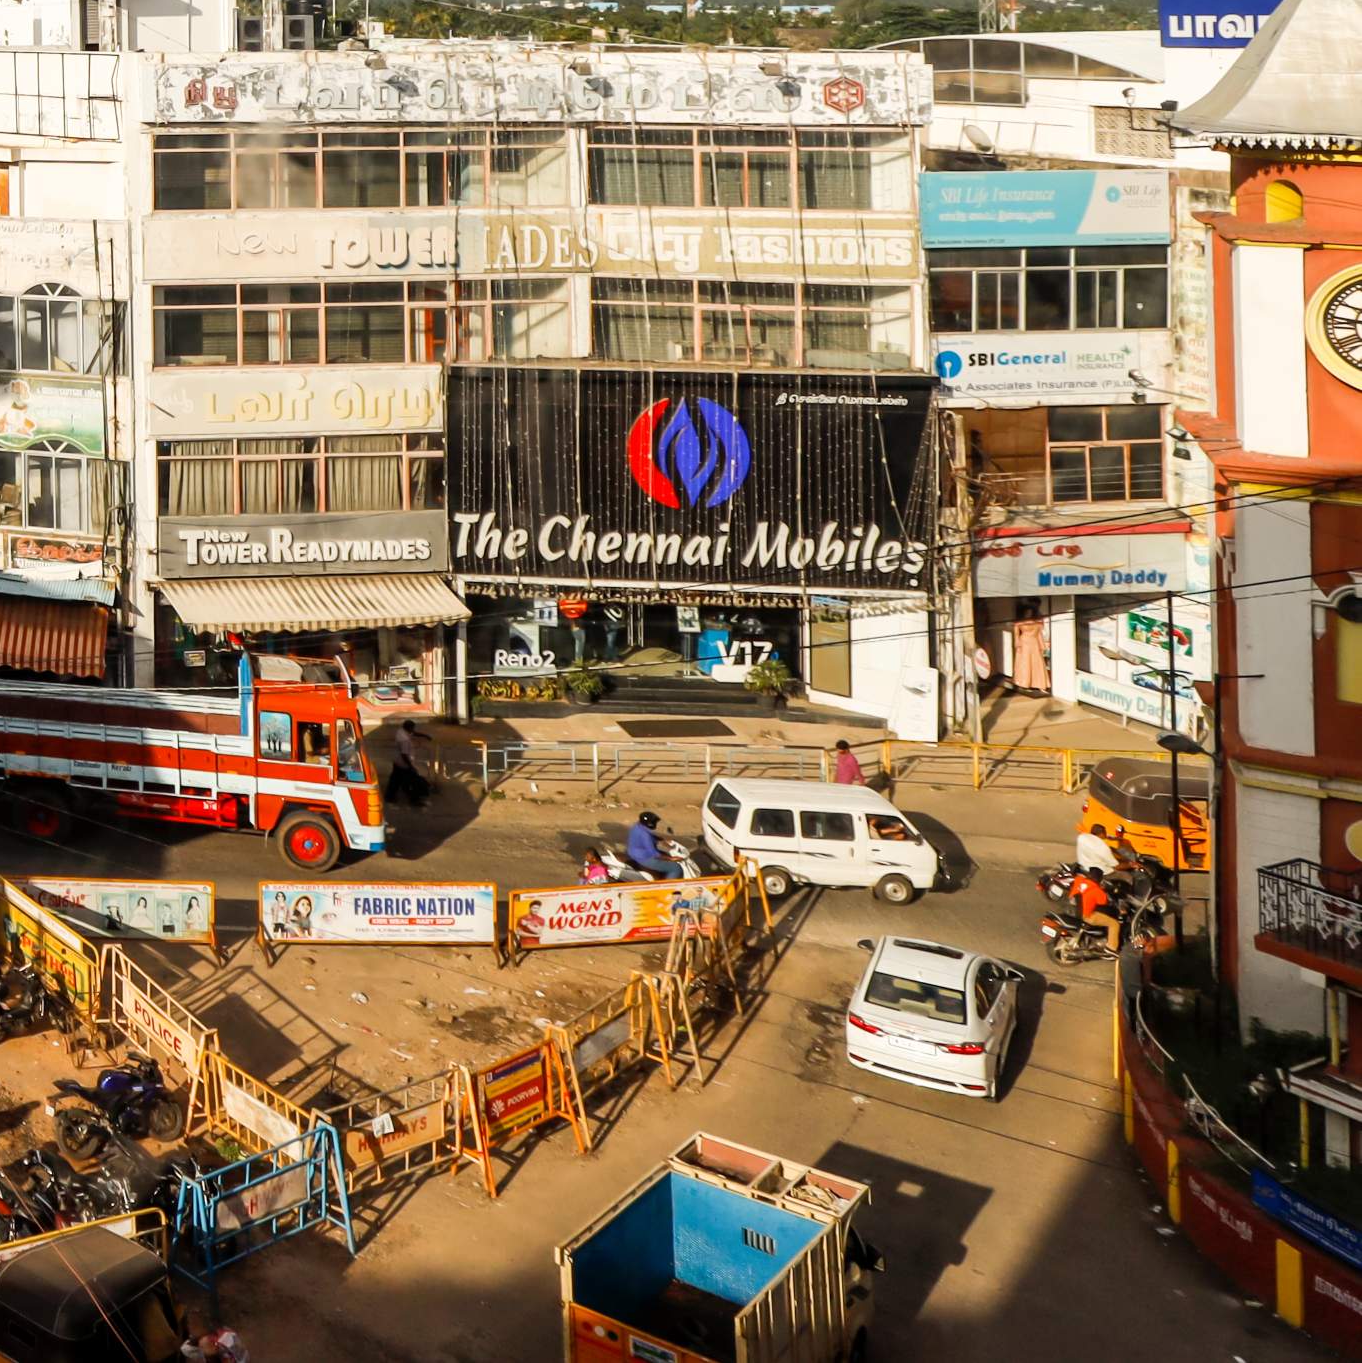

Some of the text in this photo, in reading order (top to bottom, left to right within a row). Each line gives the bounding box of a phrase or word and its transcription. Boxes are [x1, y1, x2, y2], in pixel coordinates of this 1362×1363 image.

[315, 225, 460, 270] TOWER
[968, 351, 1067, 367] SBI General
[965, 380, 1033, 392] Associates
[1037, 379, 1098, 389] Insurance
[179, 527, 431, 565] TOWER READYMADES
[453, 511, 927, 575] The Chennai Mobiles
[1038, 569, 1168, 588] Mummy Daddy
[495, 648, 557, 669] Reno2
[1080, 678, 1133, 711] Mummy
[354, 897, 476, 916] FABRIC NATION
[547, 909, 623, 932] WORLD
[134, 998, 183, 1058] POLICE
